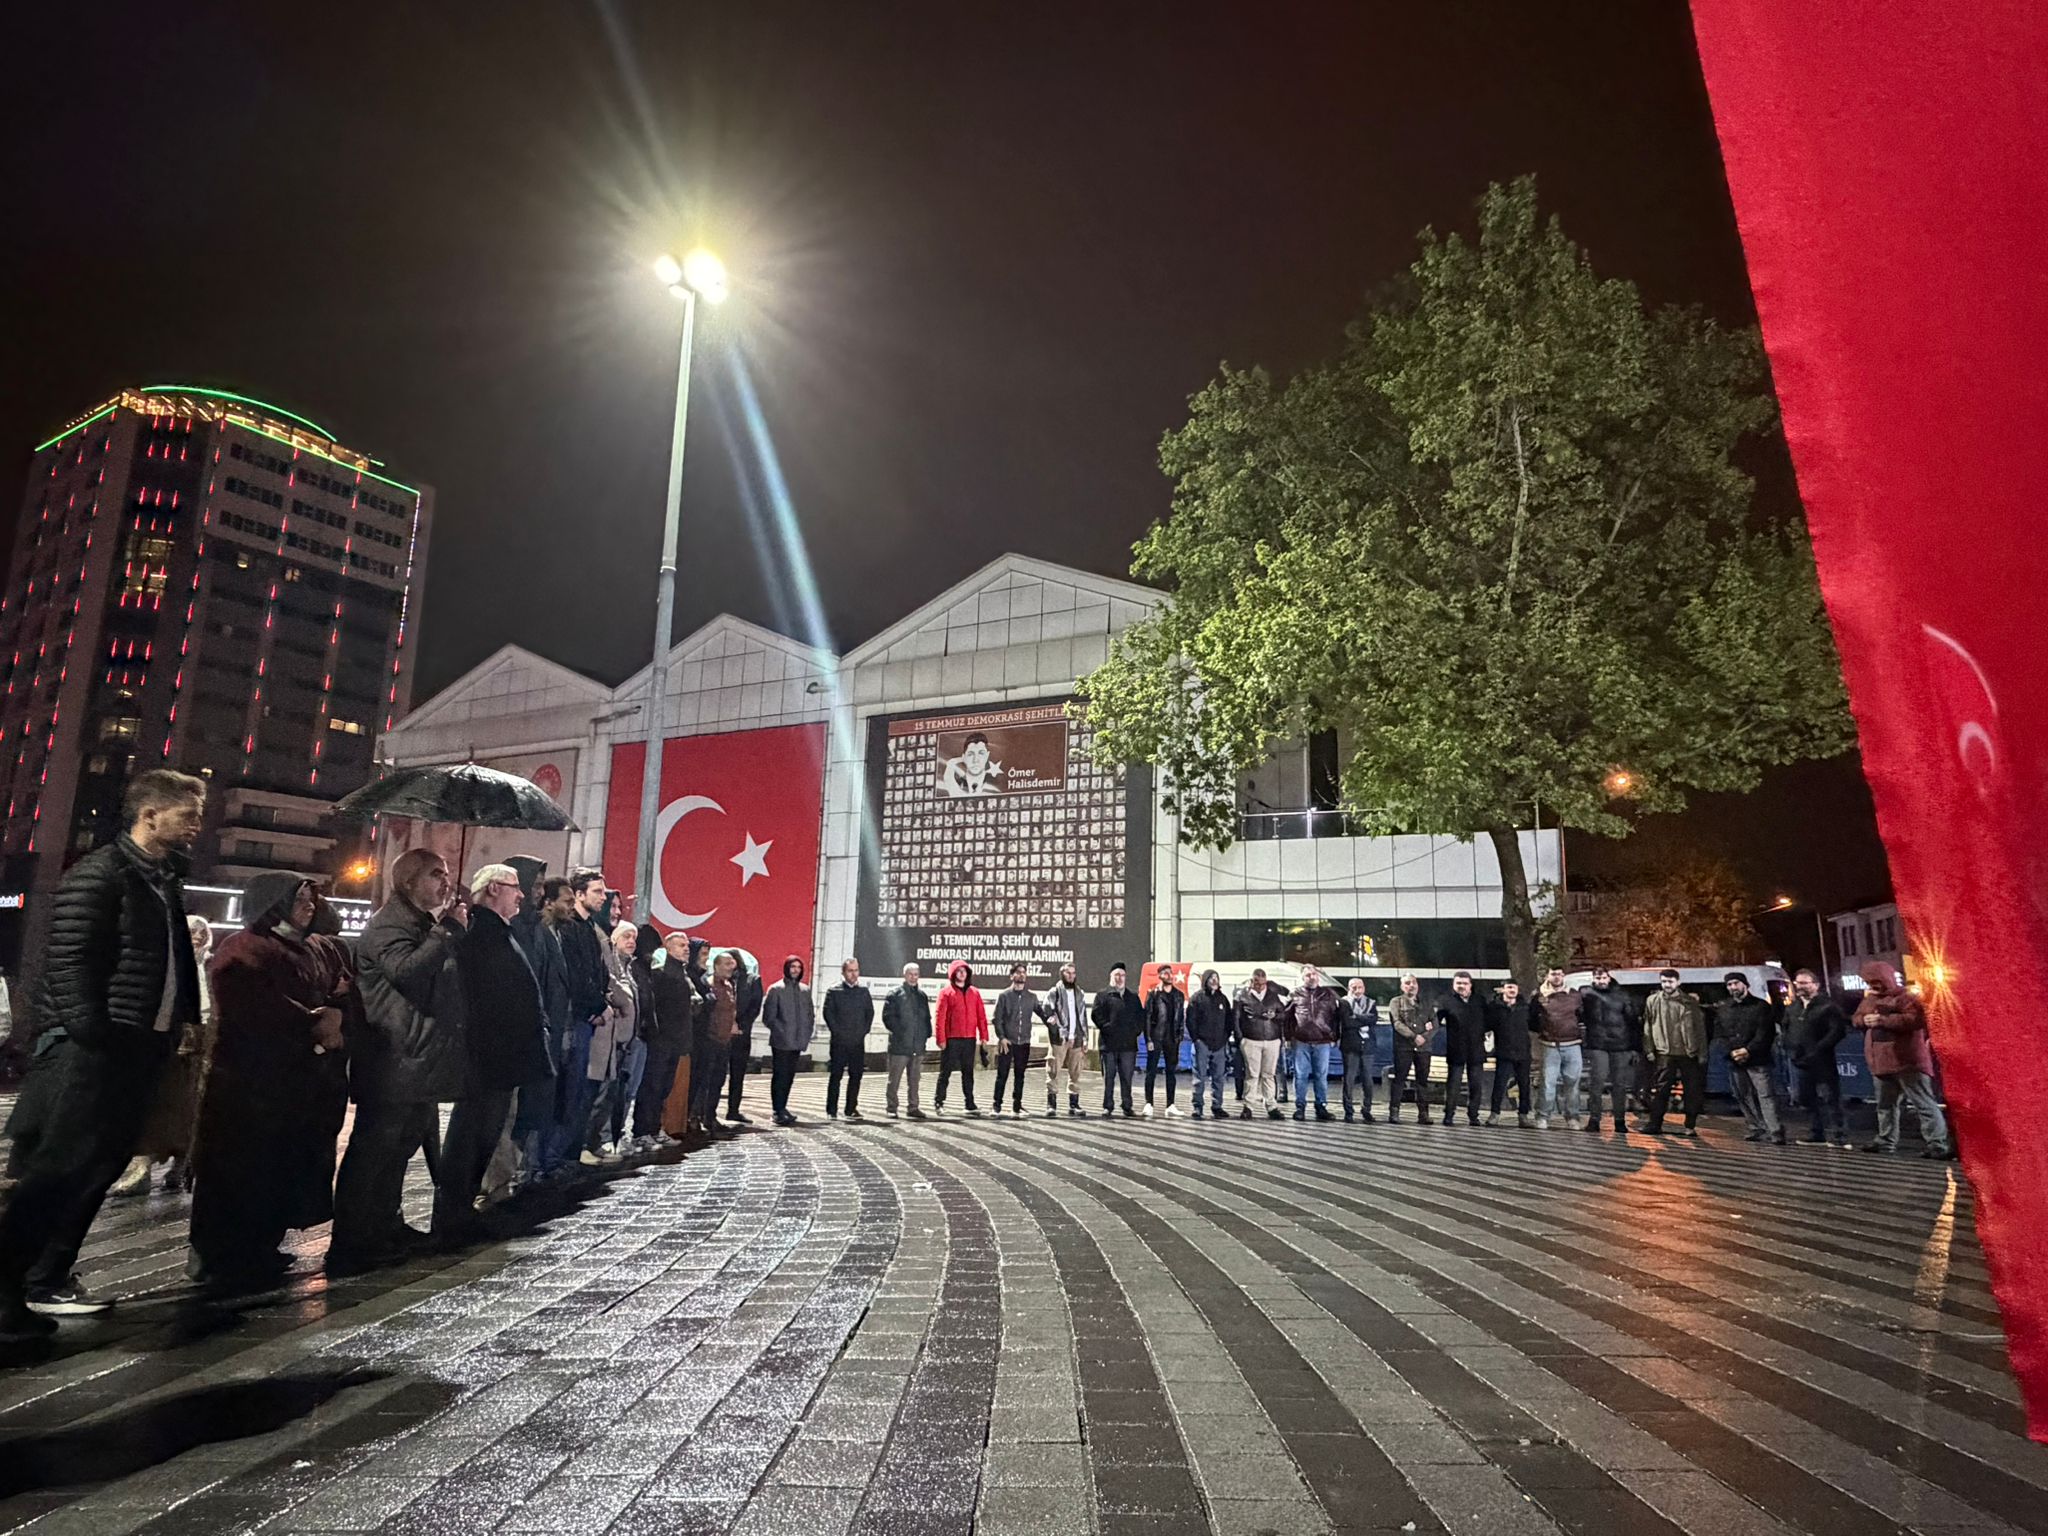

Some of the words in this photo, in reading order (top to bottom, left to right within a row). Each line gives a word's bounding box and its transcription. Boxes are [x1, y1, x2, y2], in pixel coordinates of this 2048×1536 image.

[915, 721, 925, 731] 15
[926, 718, 965, 730] TEMMUZ
[967, 711, 1024, 727] DEMOKRASİ
[1008, 766, 1036, 778] Ömer
[1008, 777, 1061, 789] Halisdemir
[930, 934, 942, 945] 15
[944, 934, 1000, 946] TEMMUZ'DA
[1002, 932, 1031, 949] ŞEHİT
[1033, 935, 1060, 947] OLAN
[916, 947, 972, 960] DEMOKRASİ
[973, 949, 1074, 963] KAHRAMANLARIMIZI
[935, 962, 949, 974] AS
